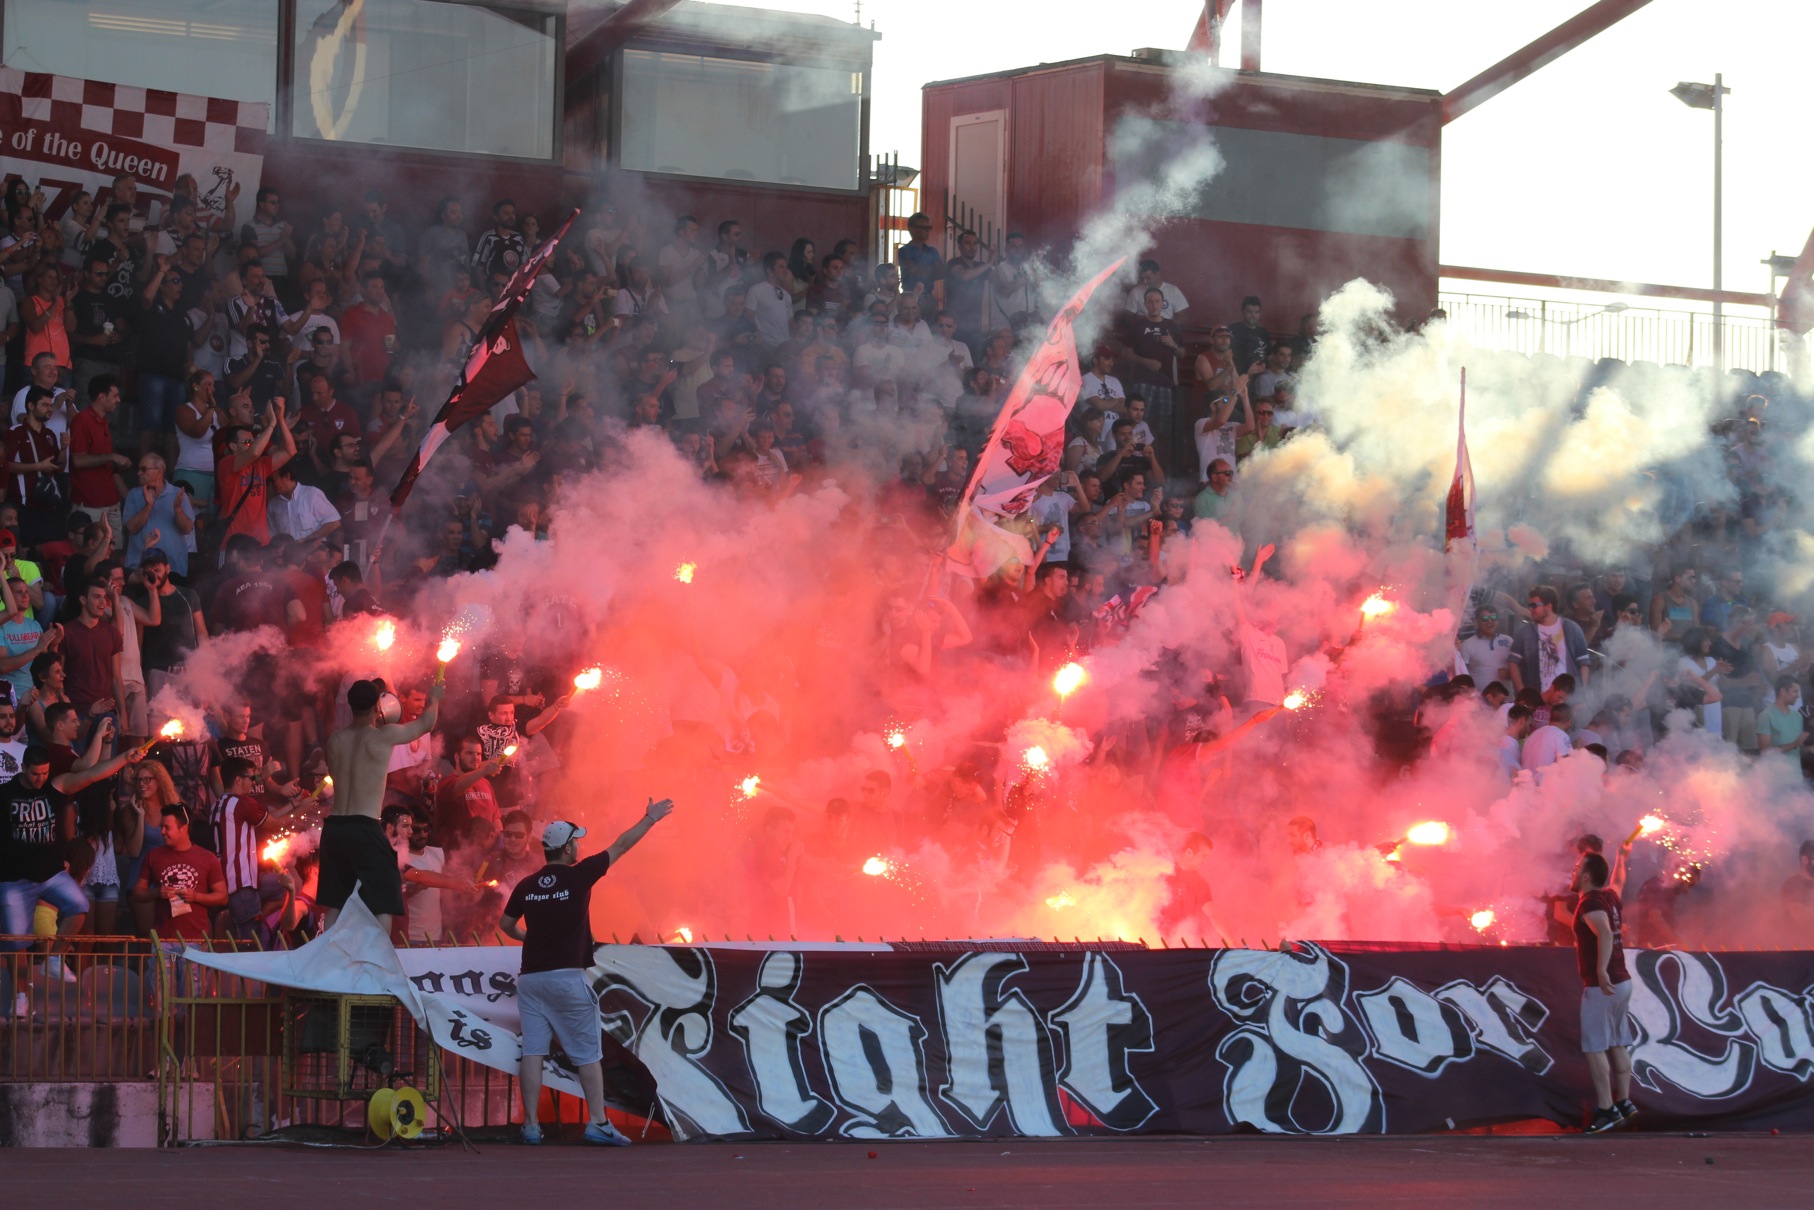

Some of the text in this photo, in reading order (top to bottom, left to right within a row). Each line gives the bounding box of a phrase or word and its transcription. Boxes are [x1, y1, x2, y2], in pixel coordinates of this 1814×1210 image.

[12, 128, 36, 151] of
[43, 132, 82, 160] the
[90, 141, 168, 182] Queen
[225, 744, 262, 756] STATEN
[448, 1010, 493, 1050] is
[1208, 941, 1554, 1135] For
